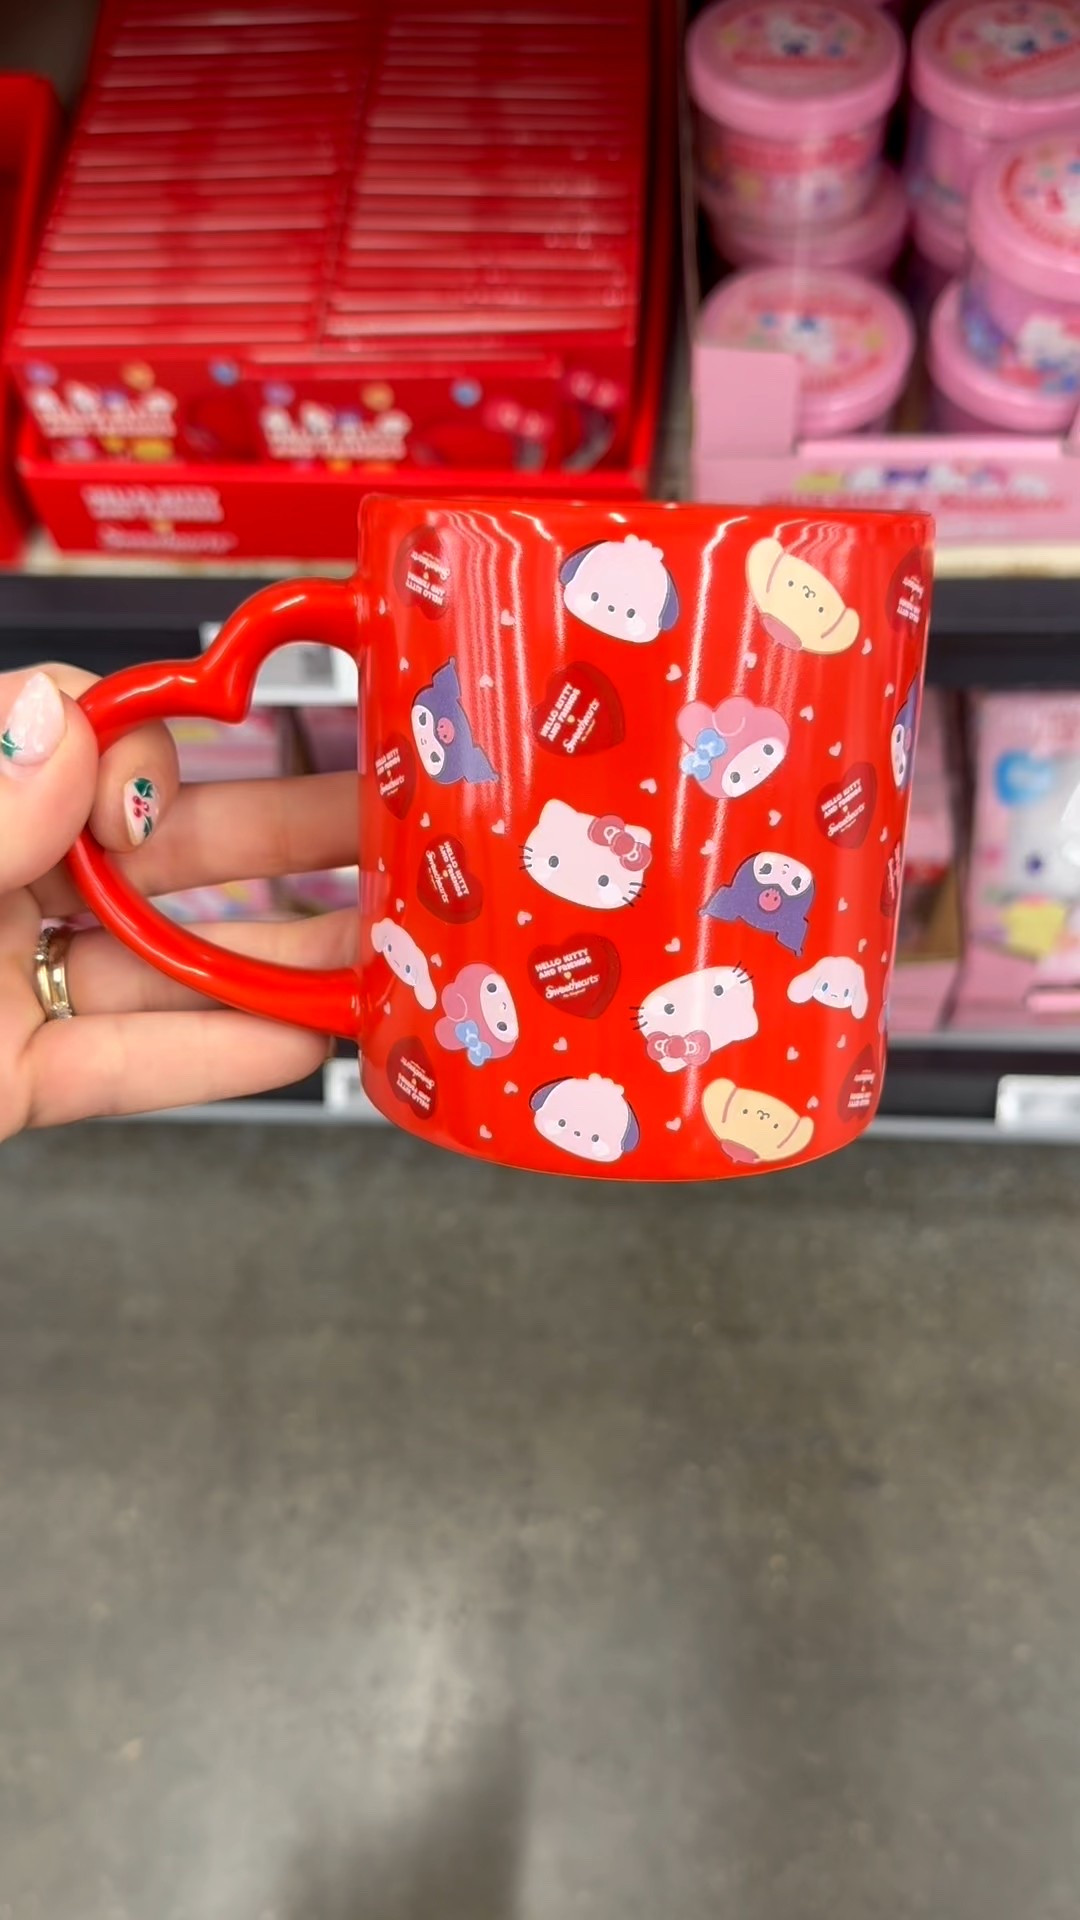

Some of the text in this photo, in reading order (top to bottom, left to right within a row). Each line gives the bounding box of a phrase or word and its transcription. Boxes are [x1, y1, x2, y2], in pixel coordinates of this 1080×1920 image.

[540, 681, 573, 737] HELLO KITTY
[548, 688, 580, 742] AND FRIENDS
[563, 698, 600, 753] Sweethearts
[821, 777, 862, 812] HELLO KITTY
[824, 805, 838, 819] AND
[425, 850, 450, 904] Sweethearts
[439, 845, 463, 897] AND FRIENDS
[444, 841, 470, 895] HELLO KITTY
[535, 947, 588, 972] HELLO KITTY
[539, 955, 592, 980] AND FRIENDS
[545, 974, 600, 999] Sweethearts
